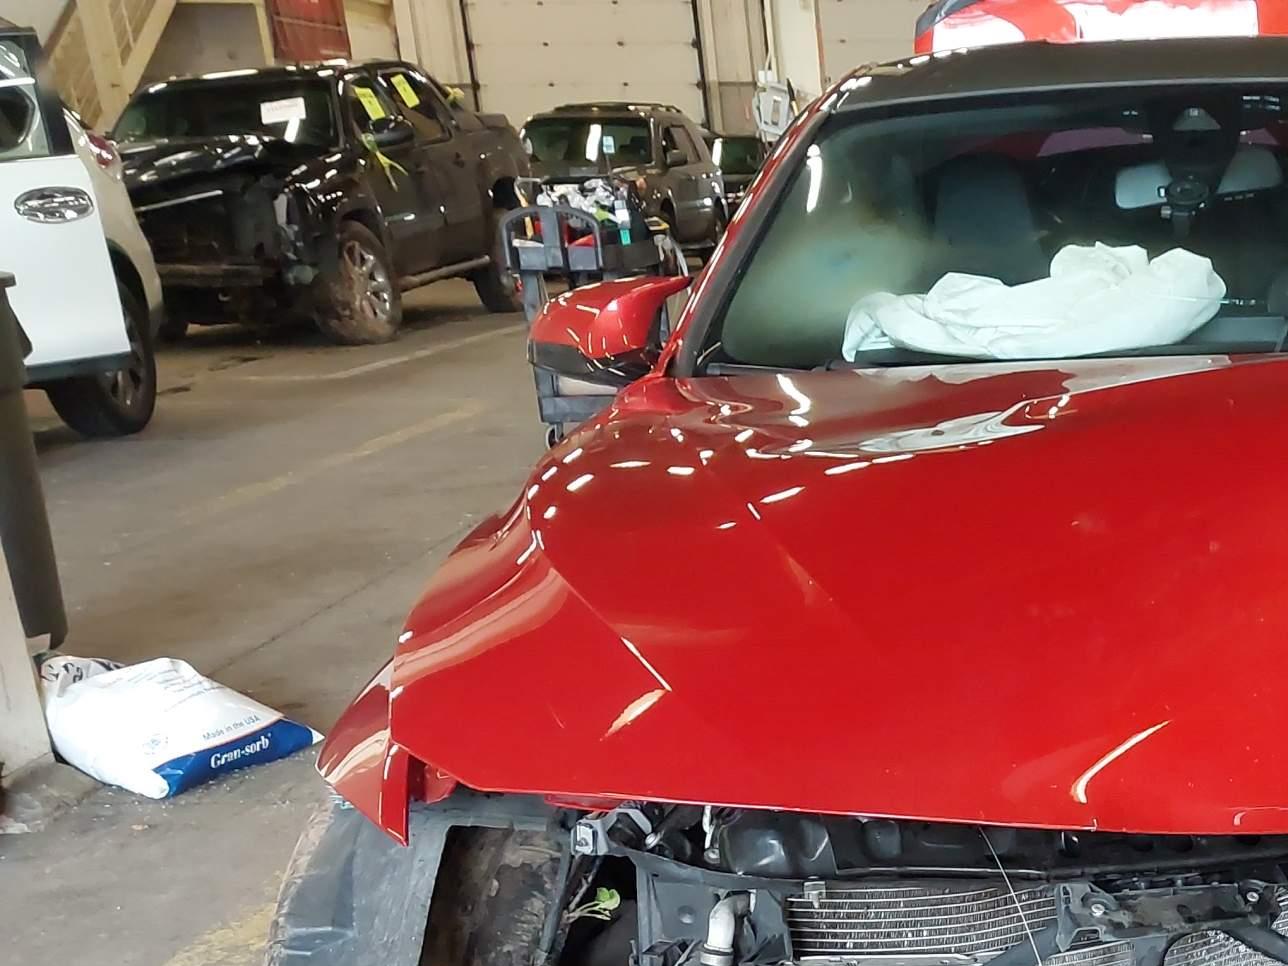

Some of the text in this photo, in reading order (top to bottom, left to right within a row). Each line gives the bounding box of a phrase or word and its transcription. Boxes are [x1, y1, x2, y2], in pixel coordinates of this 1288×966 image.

[202, 728, 225, 740] Made
[243, 714, 261, 725] USA
[210, 735, 270, 769] Gran-sorb
